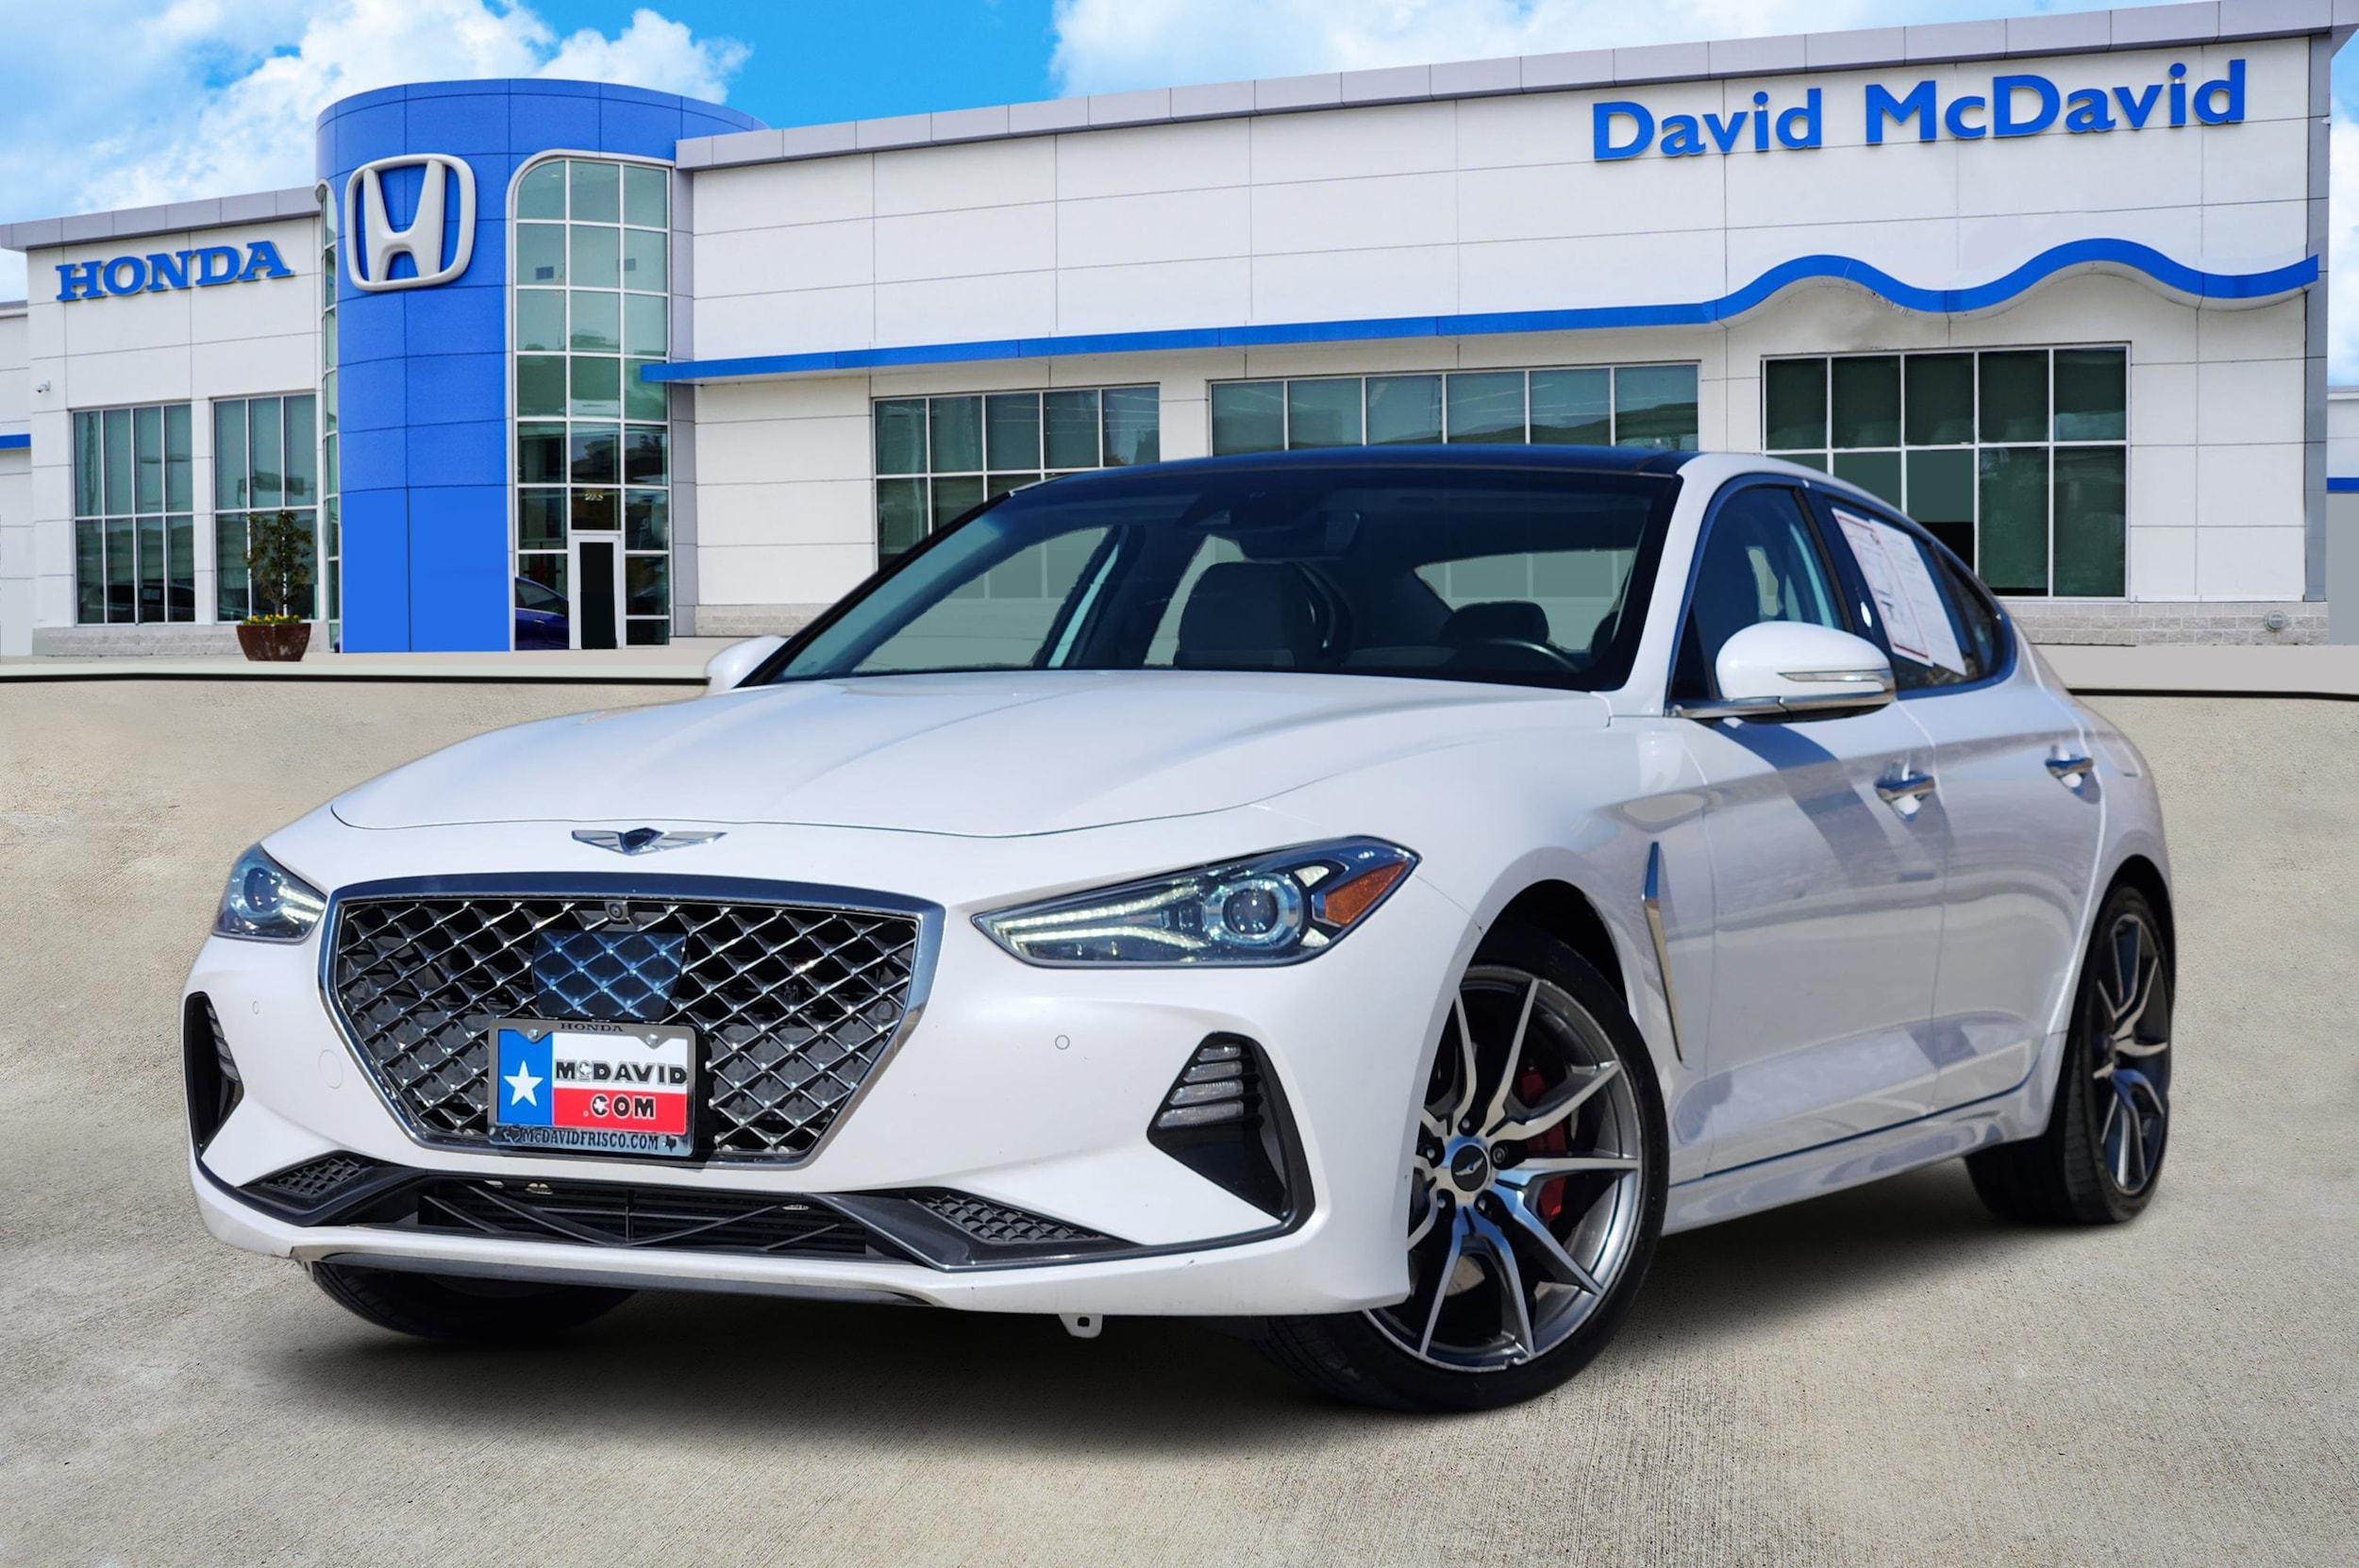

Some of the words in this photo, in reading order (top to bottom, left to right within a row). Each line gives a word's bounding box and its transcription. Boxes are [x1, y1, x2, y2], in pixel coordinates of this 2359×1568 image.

[1593, 88, 1822, 161] David
[1865, 58, 2247, 146] McDavid
[56, 240, 293, 302] HONDA
[559, 1023, 624, 1033] HONDA
